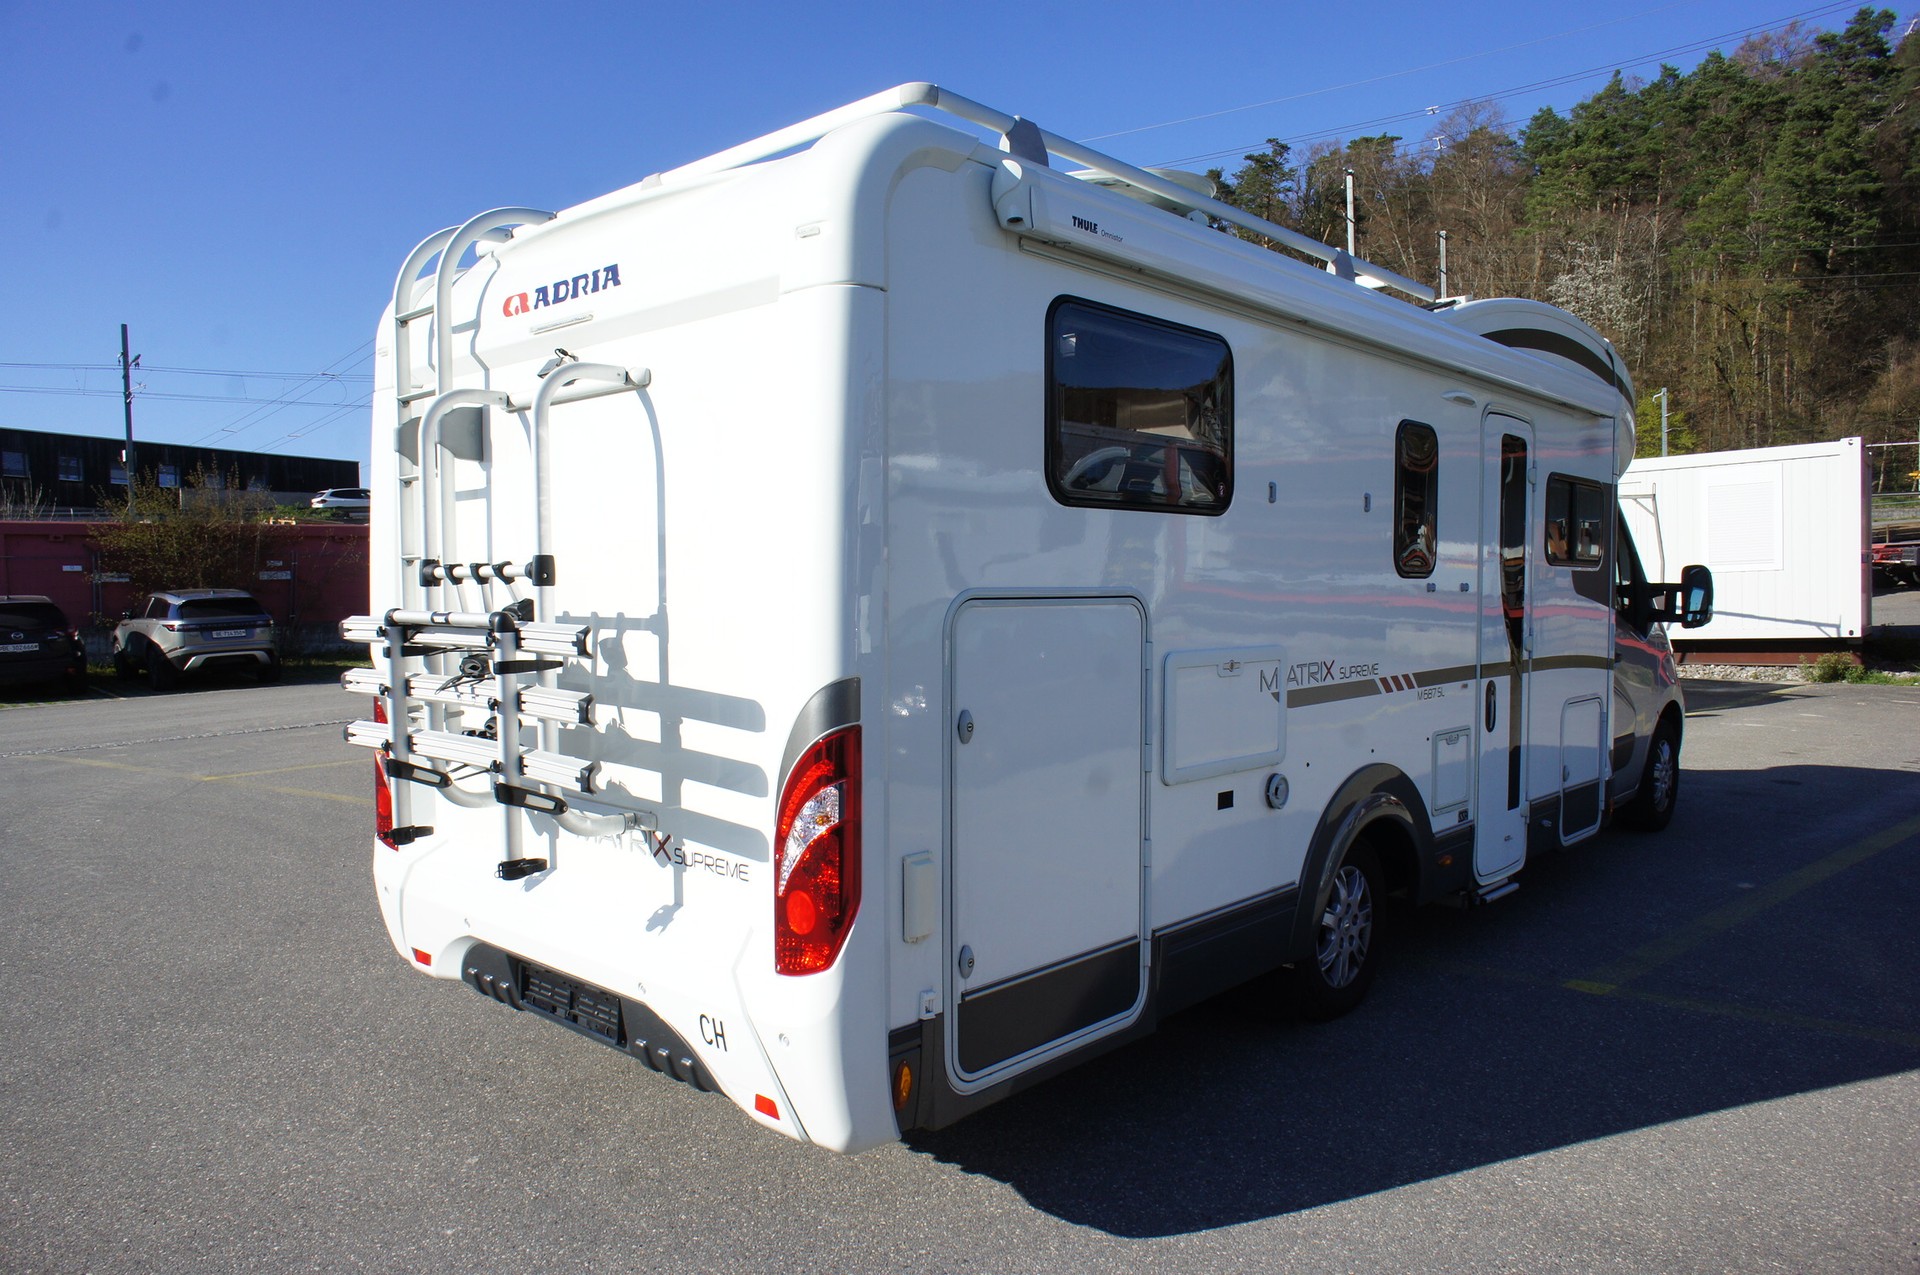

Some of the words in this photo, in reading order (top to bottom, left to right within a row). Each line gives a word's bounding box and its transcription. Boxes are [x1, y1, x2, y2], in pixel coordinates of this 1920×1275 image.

[1072, 215, 1098, 234] THULE
[534, 263, 621, 310] ADRIA
[1260, 660, 1335, 692] MATRIX
[1339, 663, 1379, 680] SUPREME
[674, 848, 749, 882] SUPREME
[700, 1014, 727, 1052] CH
